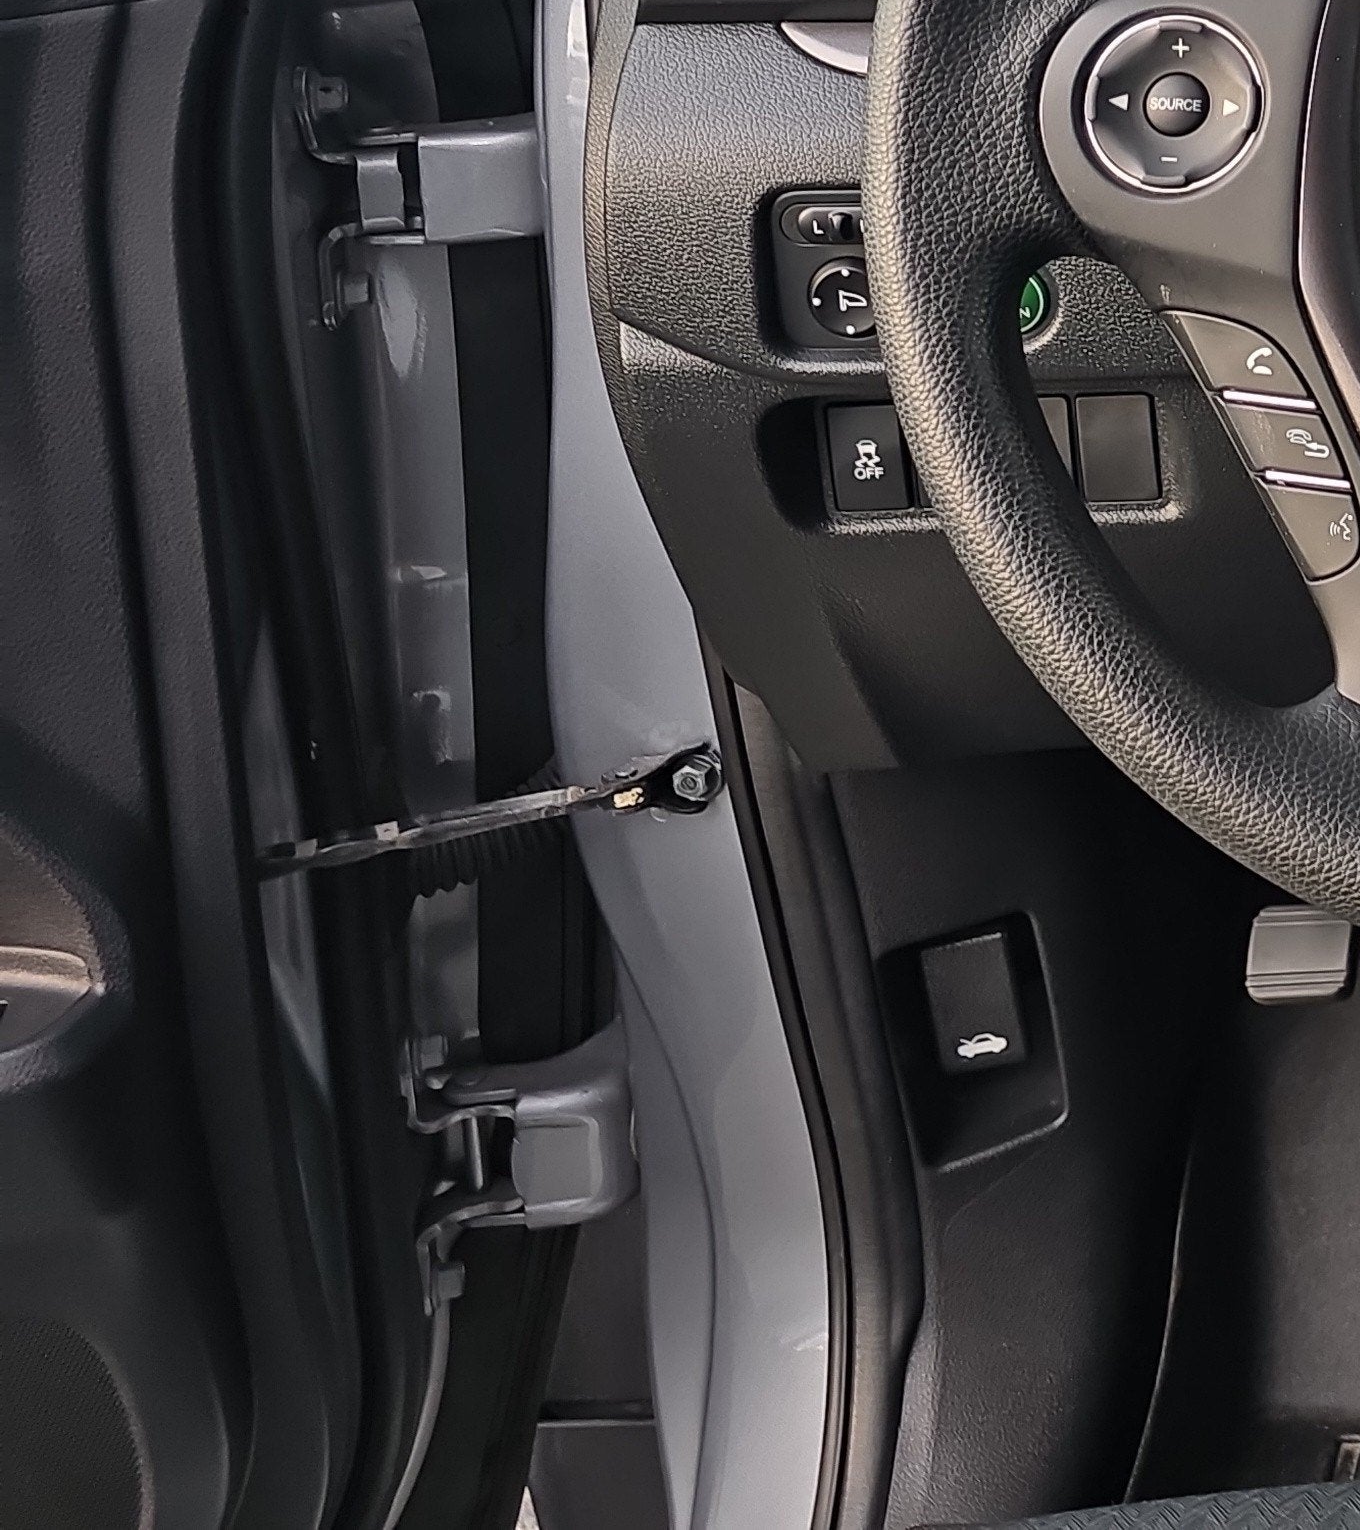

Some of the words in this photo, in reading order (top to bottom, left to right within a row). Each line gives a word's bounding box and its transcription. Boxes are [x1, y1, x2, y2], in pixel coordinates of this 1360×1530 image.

[1150, 97, 1202, 113] SOURCE
[812, 219, 825, 235] L
[854, 466, 884, 480] OFF
